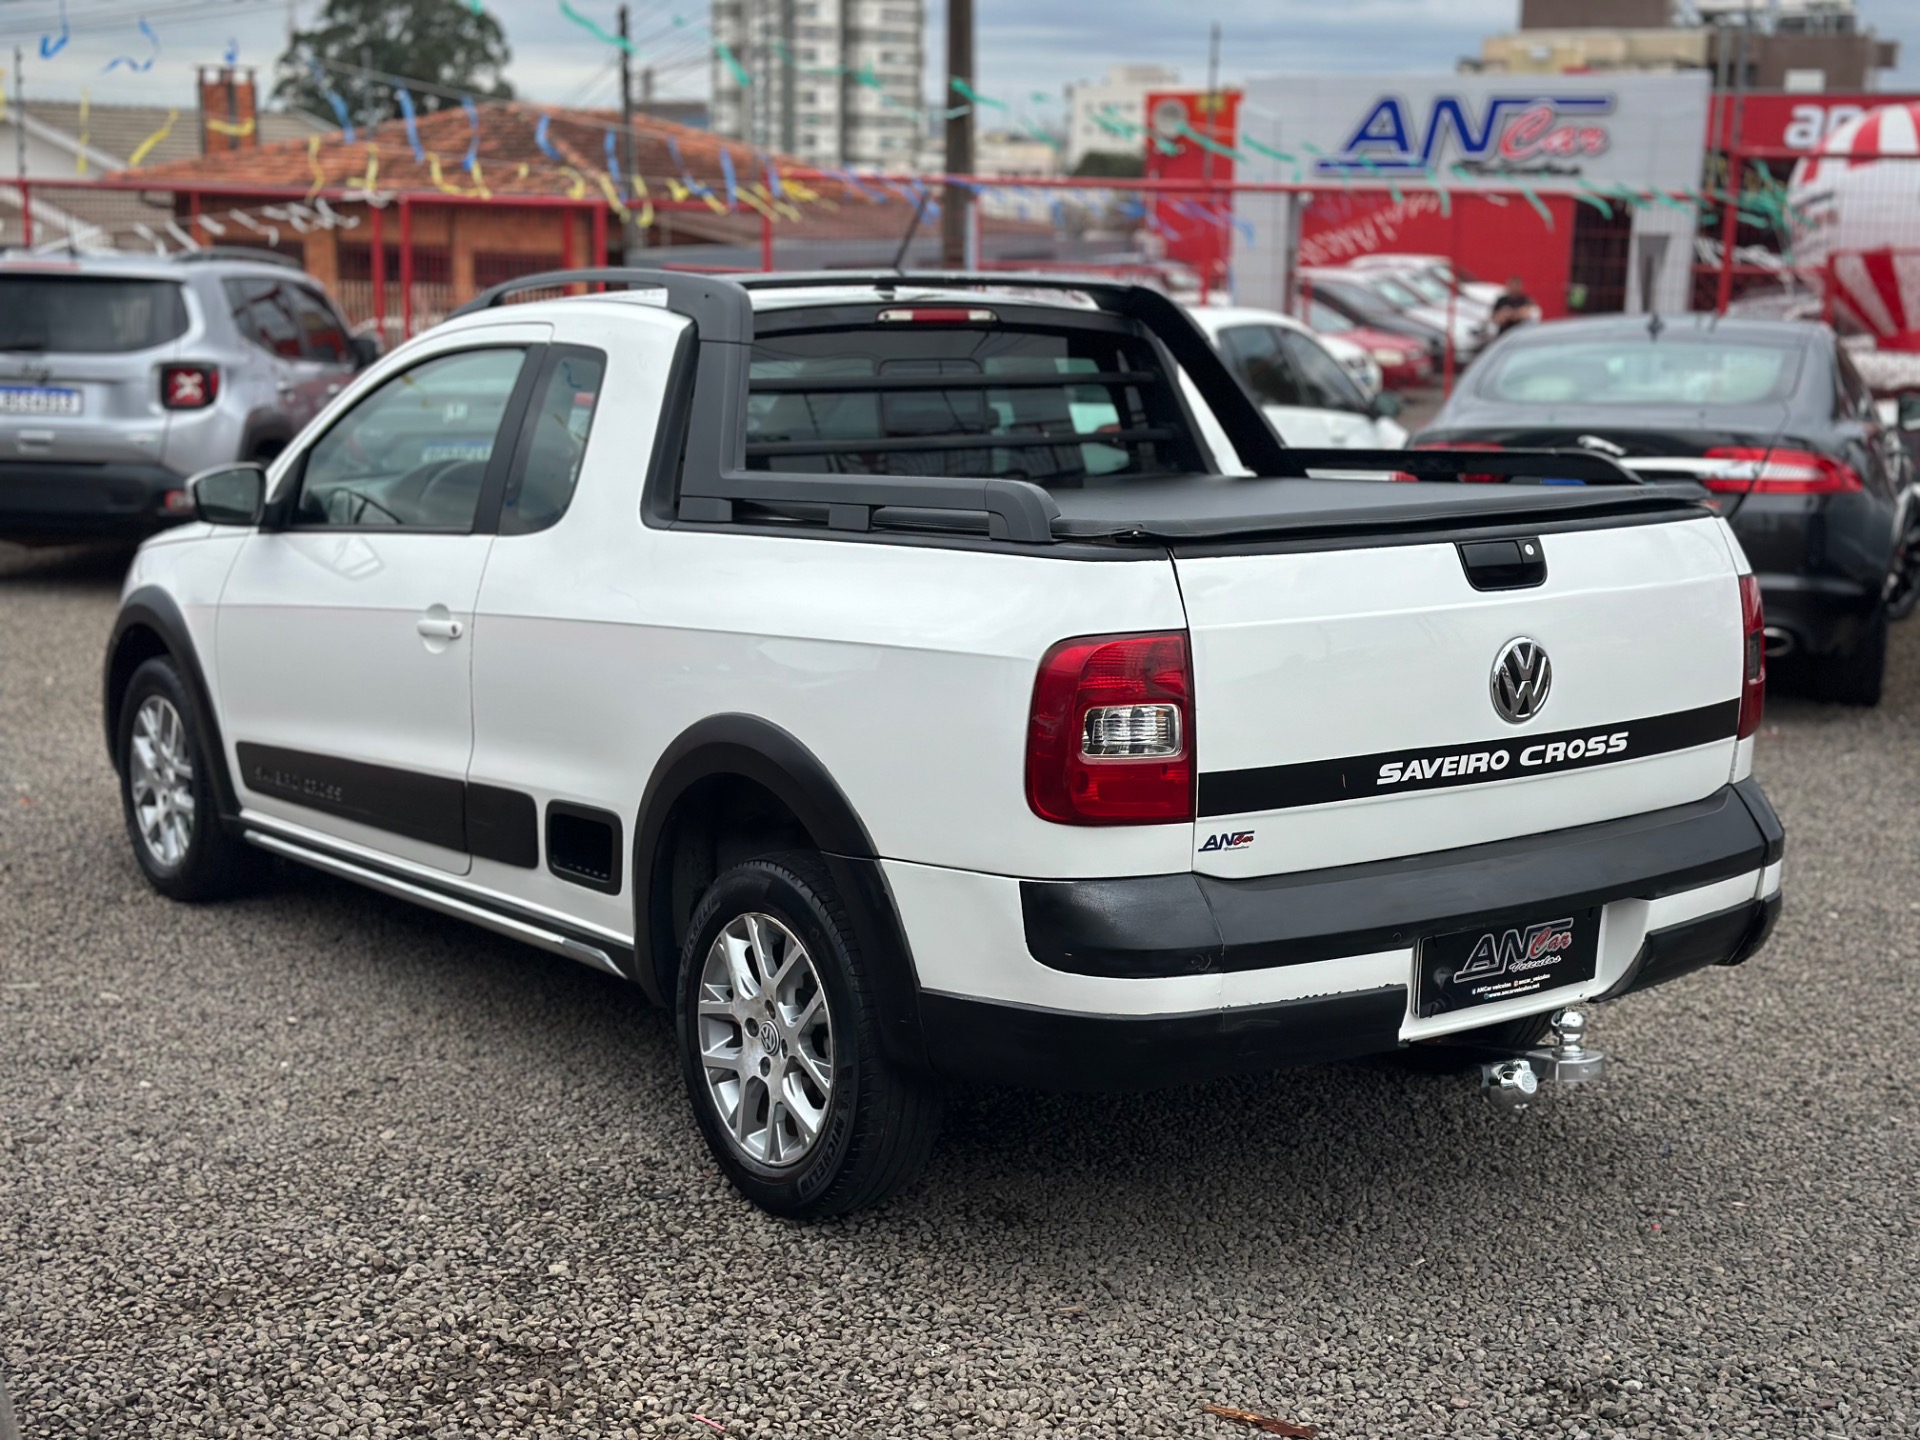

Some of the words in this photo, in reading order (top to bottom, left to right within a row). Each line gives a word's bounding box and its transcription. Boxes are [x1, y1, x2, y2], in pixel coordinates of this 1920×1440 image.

[1500, 105, 1606, 161] Car
[1376, 749, 1510, 785] SAVEIRO
[1519, 731, 1629, 766] CROSS
[1530, 927, 1572, 957] Car
